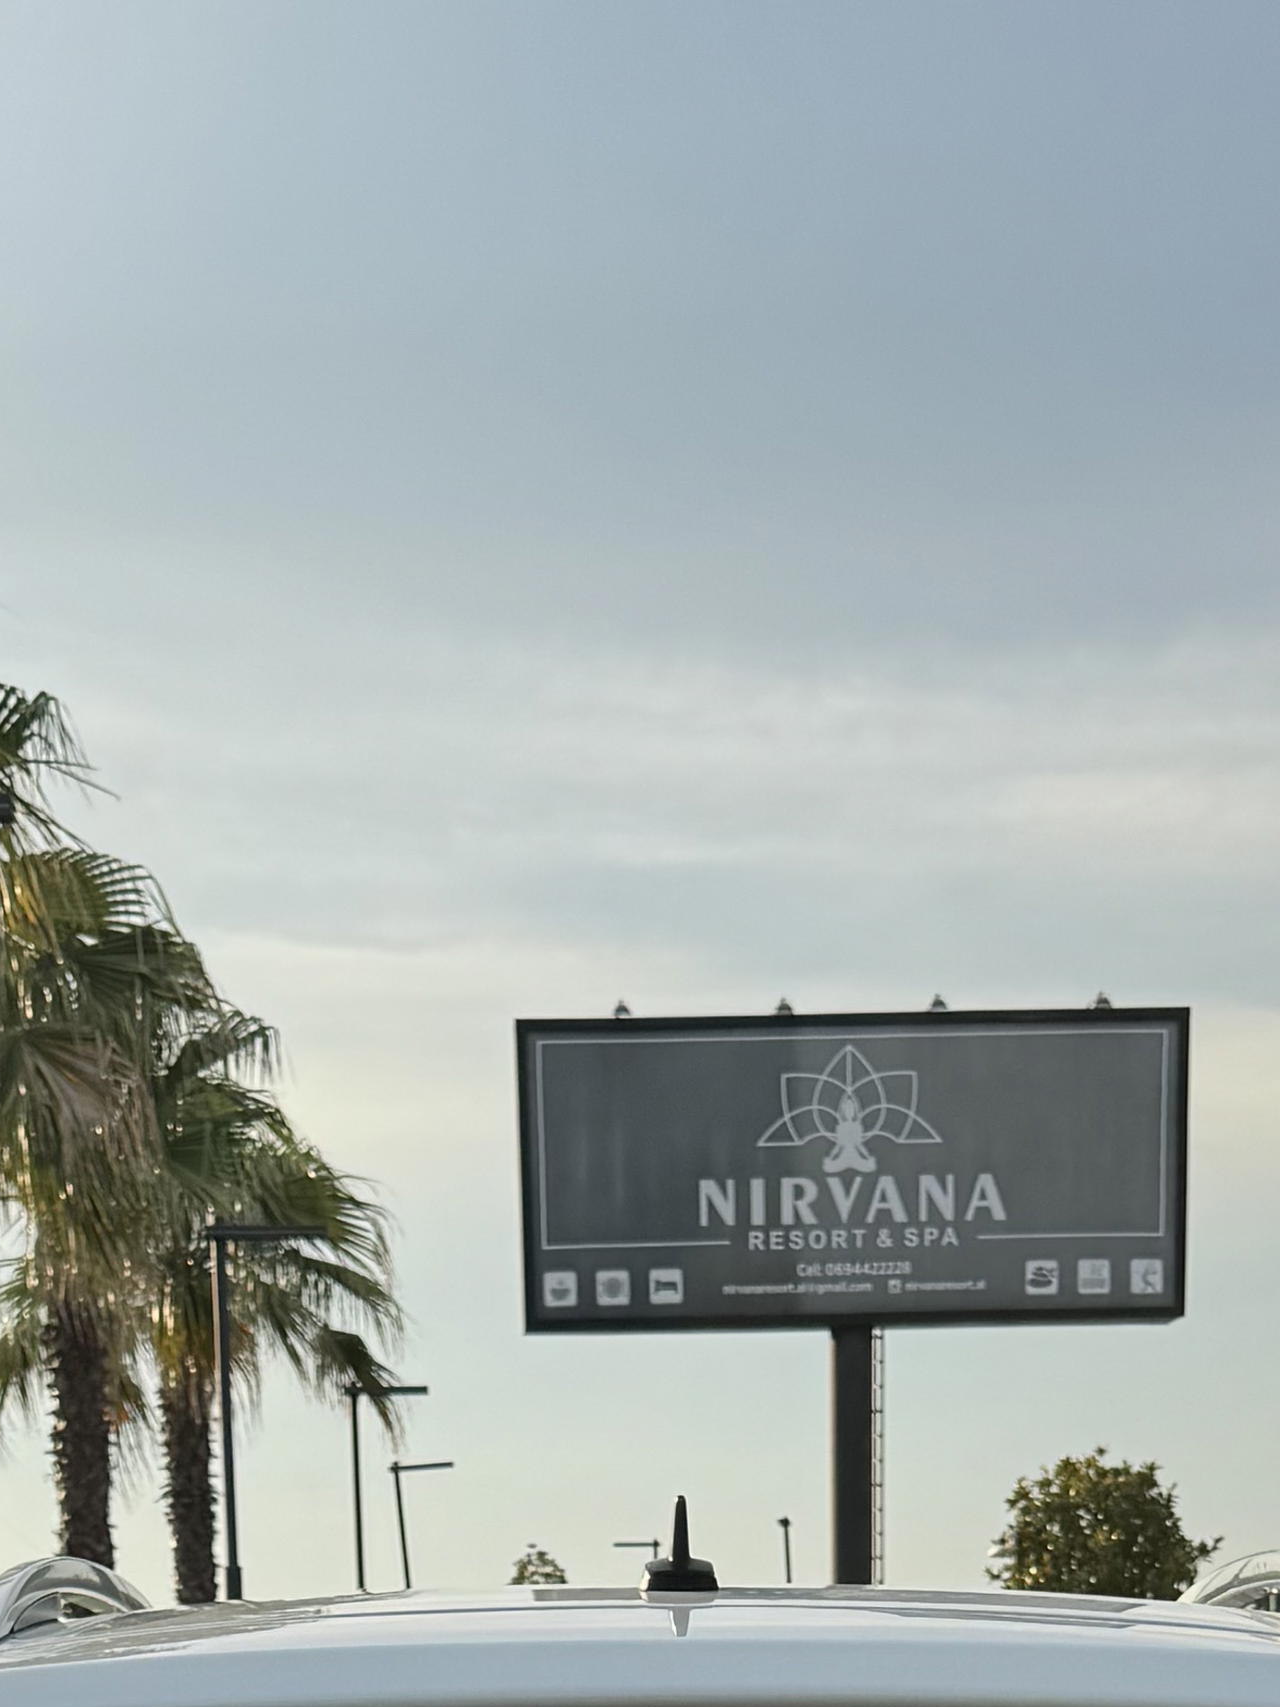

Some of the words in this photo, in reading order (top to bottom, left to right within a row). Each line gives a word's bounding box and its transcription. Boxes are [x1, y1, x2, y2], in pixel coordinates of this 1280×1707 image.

[698, 1173, 1007, 1226] NIRVANA
[748, 1229, 867, 1250] RESORT
[876, 1227, 894, 1248] &
[904, 1226, 960, 1248] SPA
